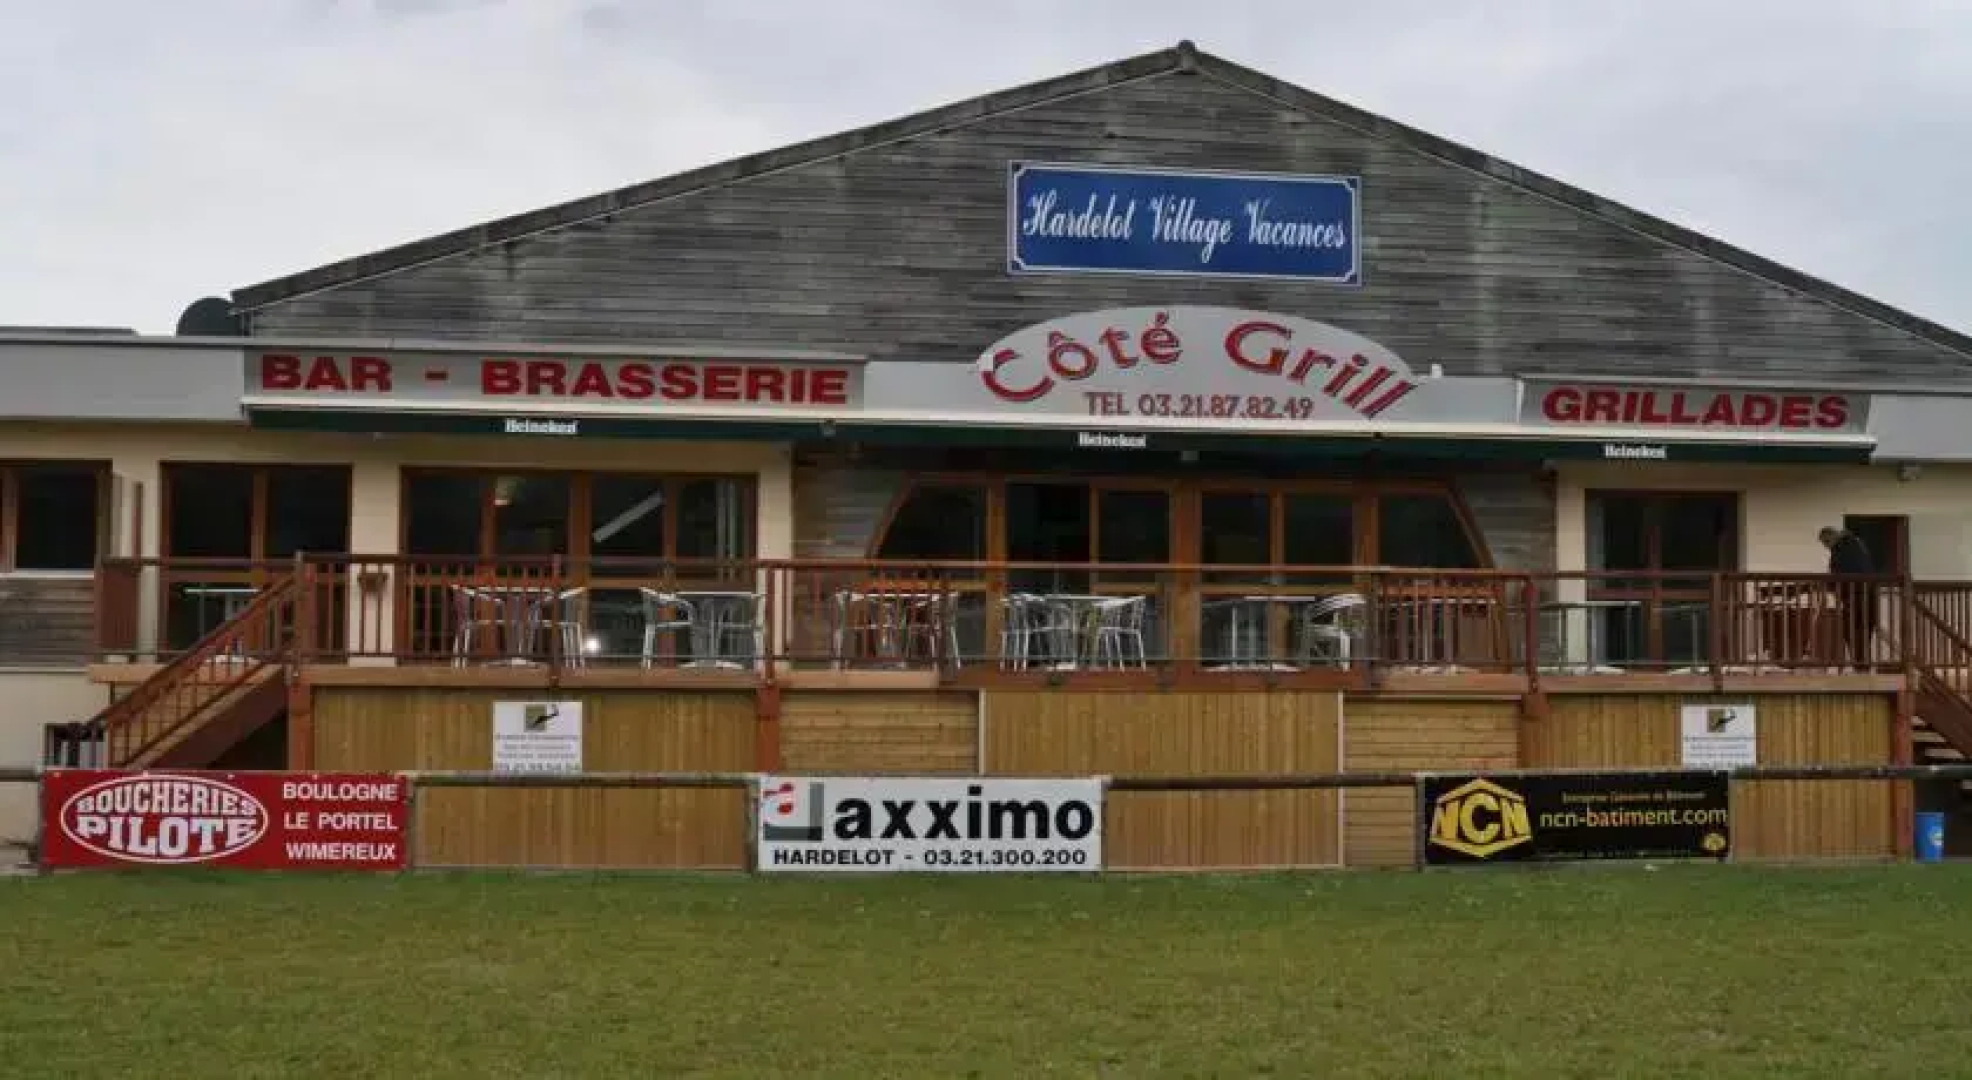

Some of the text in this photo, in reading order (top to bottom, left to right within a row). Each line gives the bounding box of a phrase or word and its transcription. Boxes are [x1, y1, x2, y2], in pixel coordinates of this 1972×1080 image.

[1023, 188, 1346, 263] Hardelot Village Vacances
[982, 311, 1418, 418] Côté Grill
[262, 354, 392, 392] BAR
[480, 360, 849, 404] BRASSERIE
[1084, 392, 1314, 419] TEL 03.21.87.82.49
[1542, 387, 1849, 429] GRILLADES
[504, 417, 578, 435] Heineken
[1078, 431, 1147, 449] Heineken
[1604, 444, 1668, 460] Heineken
[76, 781, 257, 817] BOUCHERIES
[284, 782, 398, 801] BOULOGNE
[284, 812, 398, 830] LE PORTEL
[834, 785, 1095, 842] axximo
[1436, 792, 1531, 844] NCN
[1540, 804, 1728, 829] ncn-batiment.com
[76, 816, 256, 857] PILOTE
[286, 842, 396, 860] WIMEREUX
[774, 850, 895, 866] HARDELOT
[925, 850, 1087, 866] 03.21.300.200
